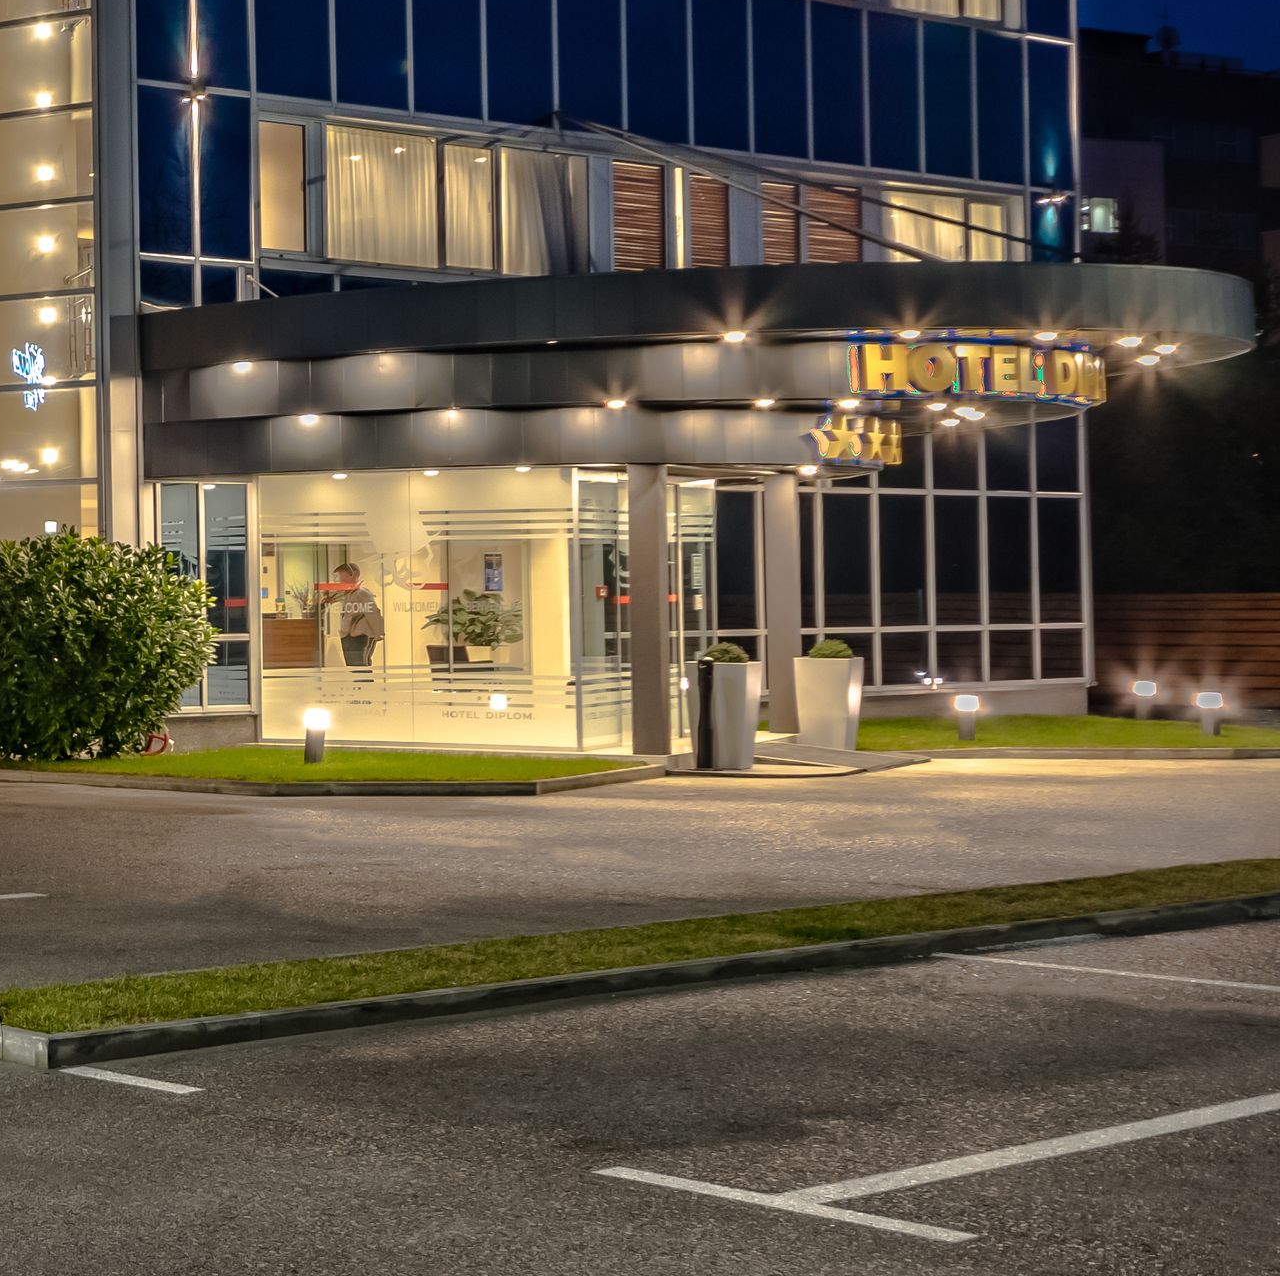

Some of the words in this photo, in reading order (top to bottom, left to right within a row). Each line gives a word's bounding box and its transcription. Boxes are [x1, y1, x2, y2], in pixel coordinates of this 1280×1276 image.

[860, 344, 1042, 393] HOTEL
[441, 710, 480, 720] HOTEL
[486, 711, 535, 721] DIPLOM
